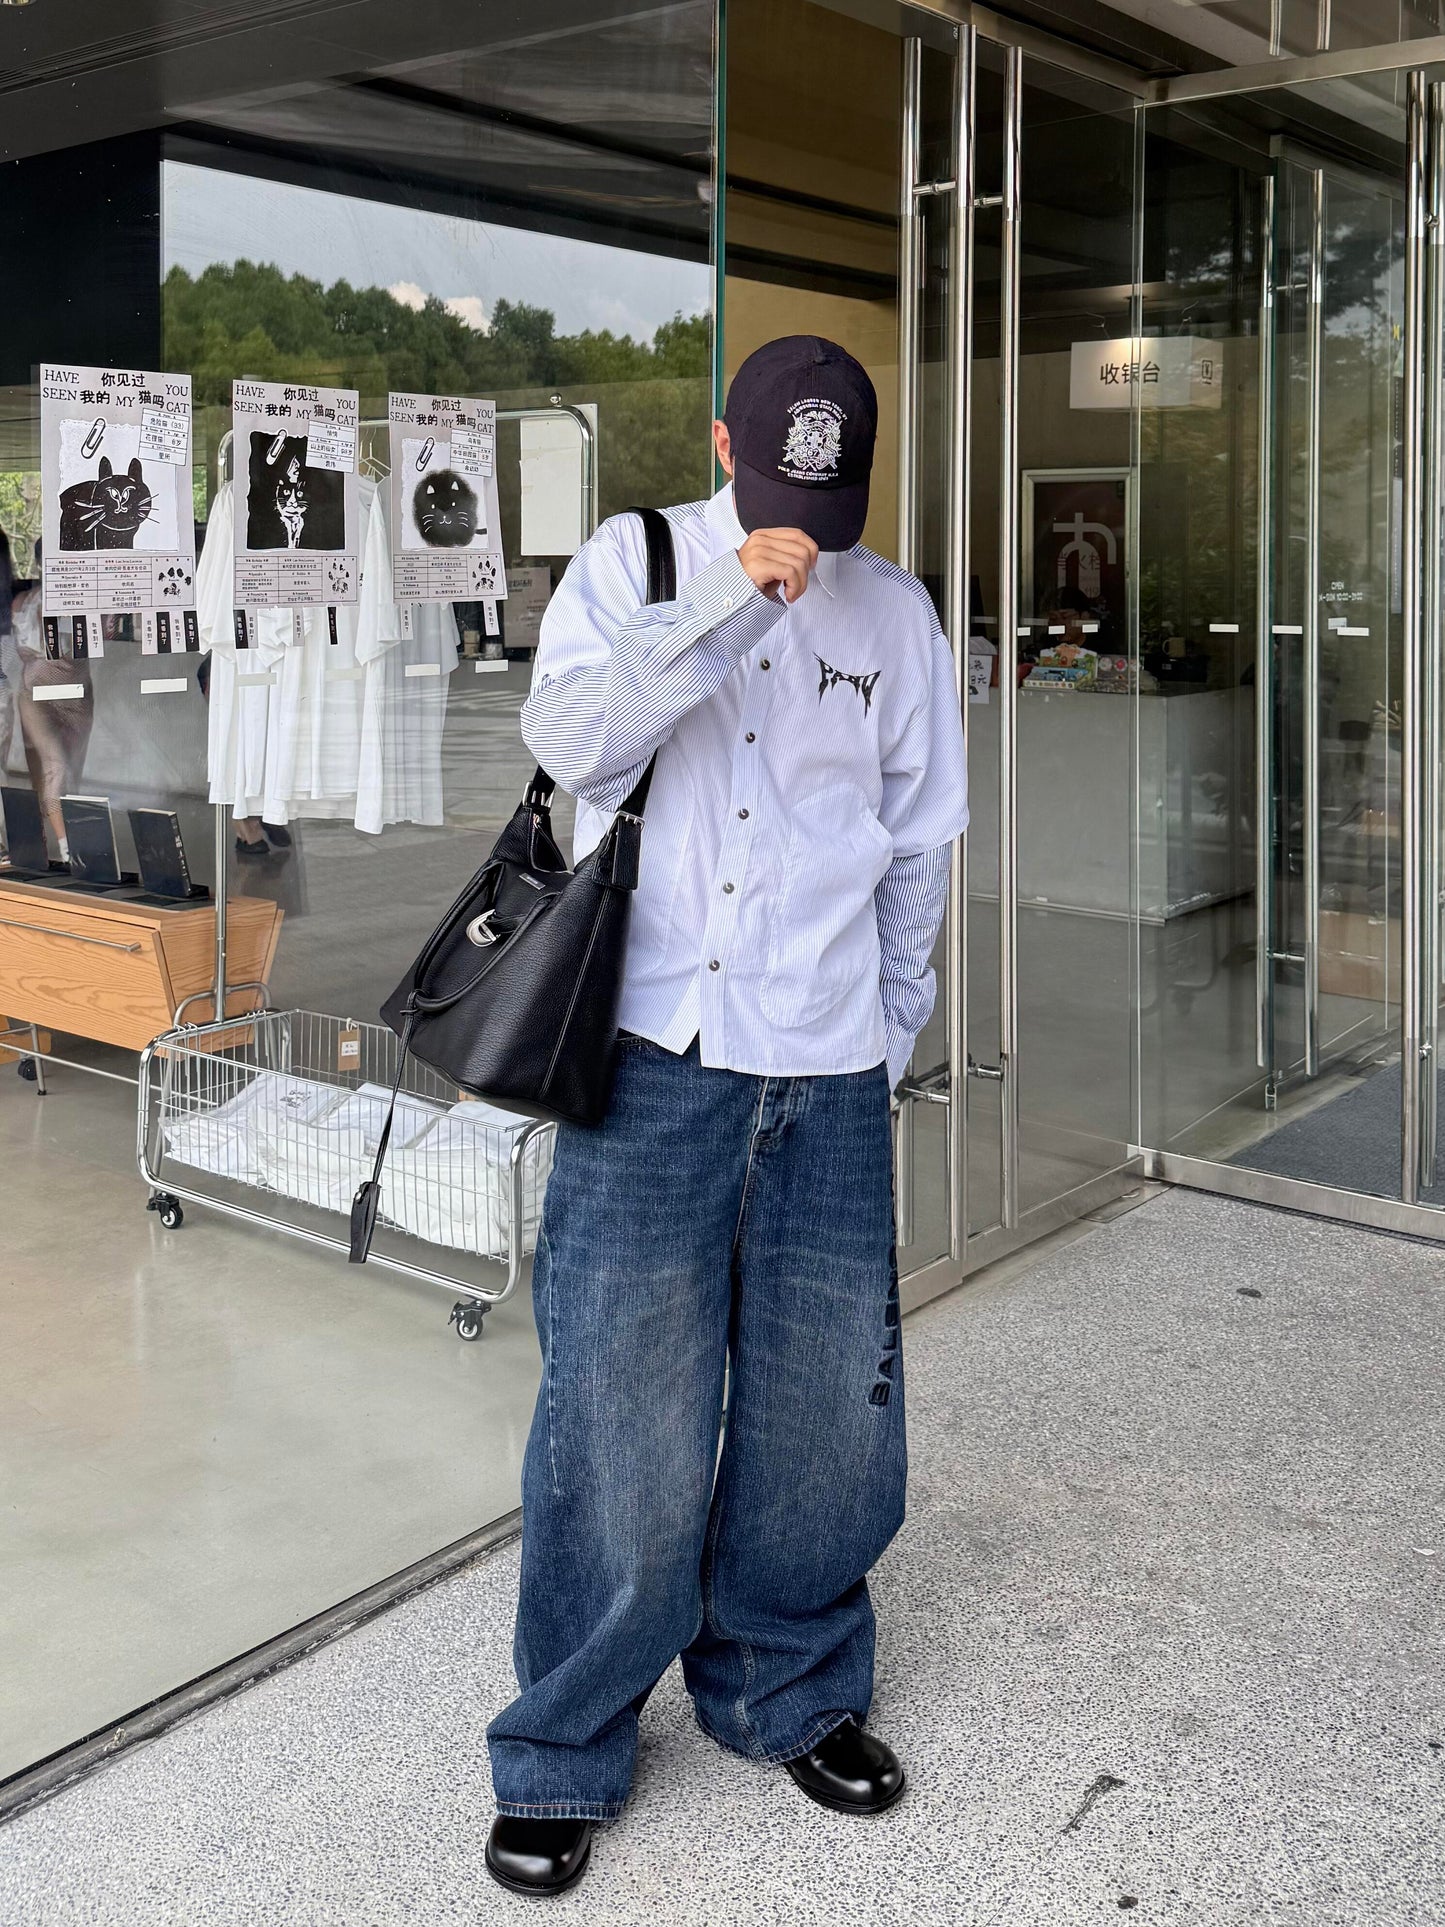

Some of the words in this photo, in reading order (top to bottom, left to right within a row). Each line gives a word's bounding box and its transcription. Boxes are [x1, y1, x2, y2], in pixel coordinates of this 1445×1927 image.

[44, 369, 79, 384] HAVE
[1099, 361, 1160, 385] 收银台
[101, 373, 146, 388] 你见过
[42, 388, 77, 401] SEEN
[80, 390, 110, 404] 我的
[165, 384, 189, 397] YOU
[236, 385, 265, 398] HAVE
[283, 388, 319, 401] 你见过
[116, 396, 136, 408] MY
[138, 390, 165, 409] 猫吗
[336, 399, 356, 410] YOU
[391, 396, 416, 409] HAVE
[432, 399, 462, 411] 你见过
[166, 402, 190, 413] CAT
[234, 401, 263, 413] SEEN
[264, 403, 292, 417] 我的
[313, 404, 336, 421] 猫吗
[476, 408, 493, 419] YOU
[296, 409, 312, 420] MY
[337, 415, 356, 426] CAT
[390, 411, 415, 423] SEEN
[416, 413, 438, 426] 我的
[456, 413, 476, 429] 猫吗
[441, 418, 454, 428] MY
[477, 423, 494, 433] CAT
